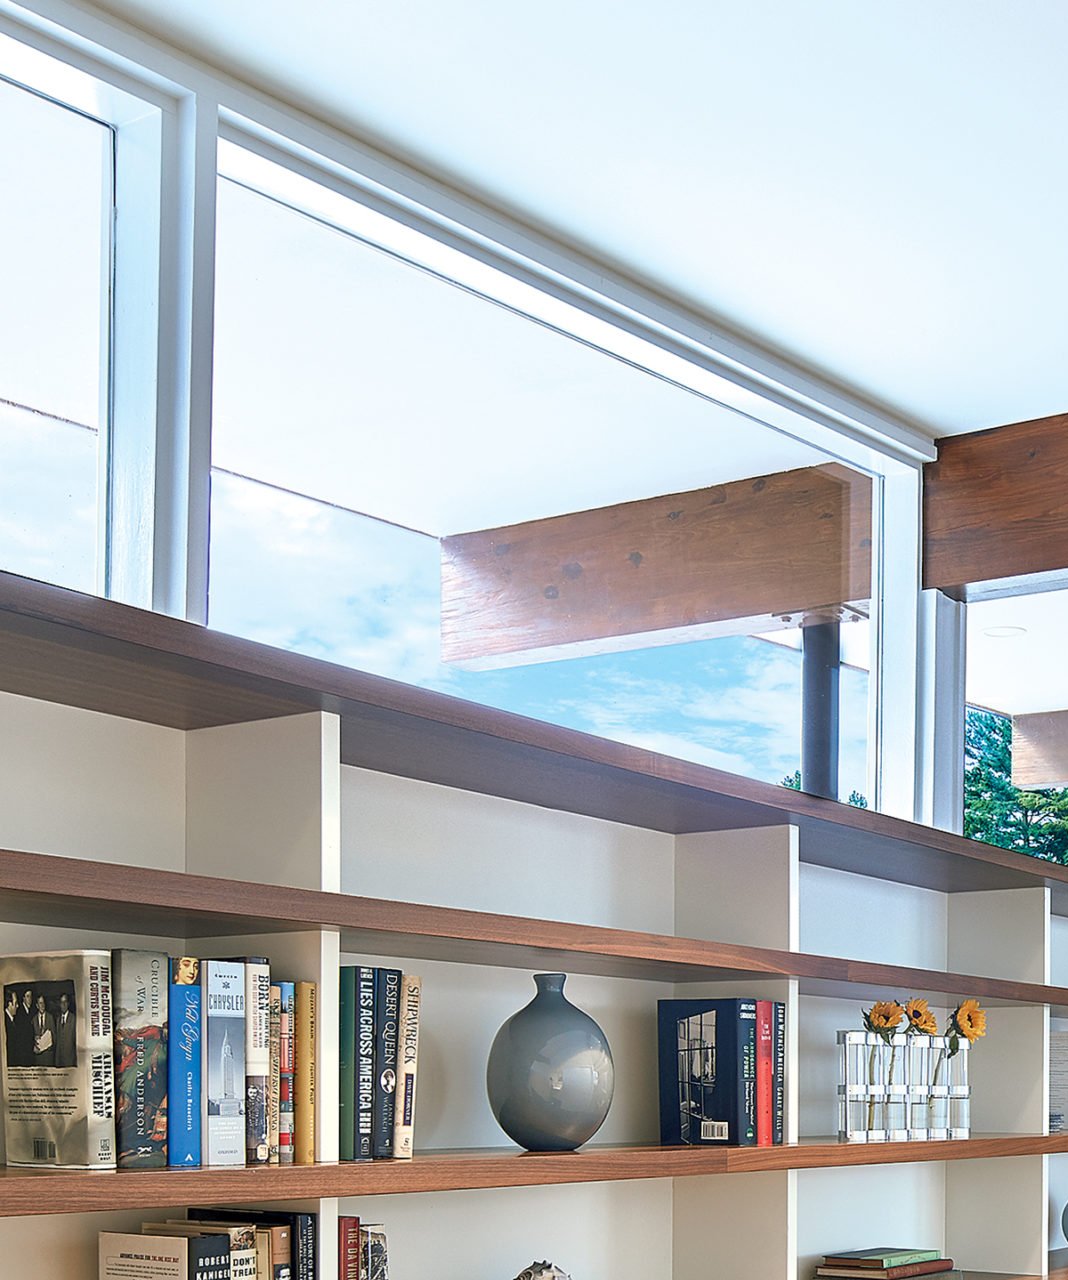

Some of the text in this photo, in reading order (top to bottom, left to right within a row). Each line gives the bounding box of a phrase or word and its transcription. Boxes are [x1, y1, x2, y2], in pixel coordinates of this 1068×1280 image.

[89, 966, 99, 1036] AND CURTIS WILKIE
[101, 966, 111, 1036] JIM McDOUGAL
[137, 987, 145, 1012] WAR
[151, 959, 160, 1018] CRUCIBLE
[209, 994, 243, 1011] CHRYSLER
[258, 975, 269, 1011] BORN
[383, 974, 397, 1064] DESERT QUEEN
[180, 991, 200, 1061] Nell Gwyn
[359, 982, 372, 1109] LIES ACROSS AMERICA
[404, 986, 418, 1064] SHIPWRECK
[91, 1055, 103, 1118] MISCHIEF
[103, 1053, 112, 1119] ARKANSAS
[136, 1036, 145, 1136] FRED ANDERSON
[199, 1255, 230, 1266] ROBERT
[233, 1257, 255, 1266] DON'T
[347, 1248, 357, 1261] DA
[348, 1227, 358, 1244] THE
